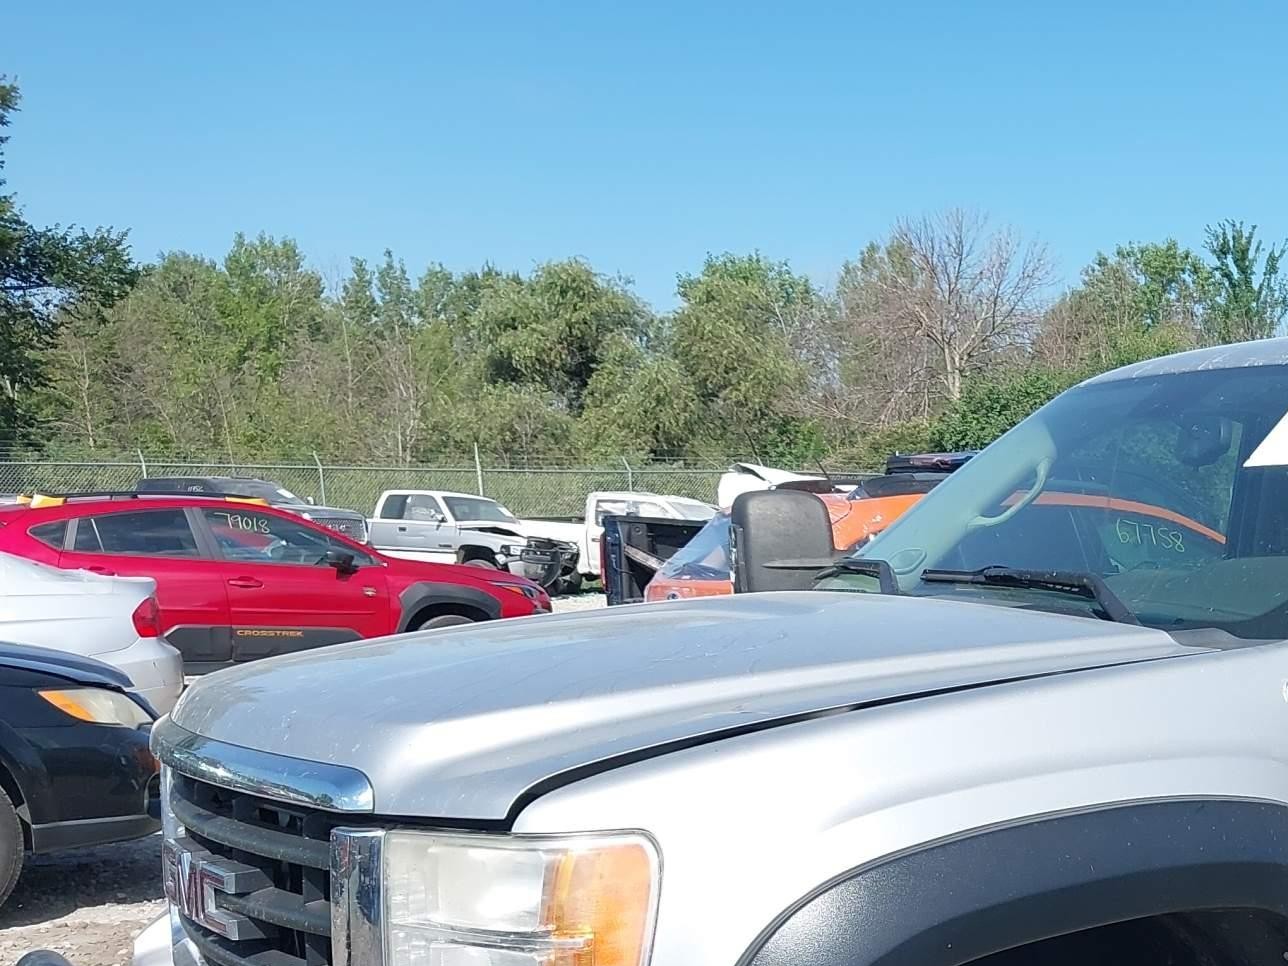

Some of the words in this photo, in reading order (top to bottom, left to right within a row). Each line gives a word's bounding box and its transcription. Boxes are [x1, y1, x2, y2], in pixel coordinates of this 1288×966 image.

[213, 512, 271, 533] 79018
[1116, 518, 1185, 552] 67758
[236, 630, 304, 638] CROSSTREK
[161, 838, 240, 942] GMC
